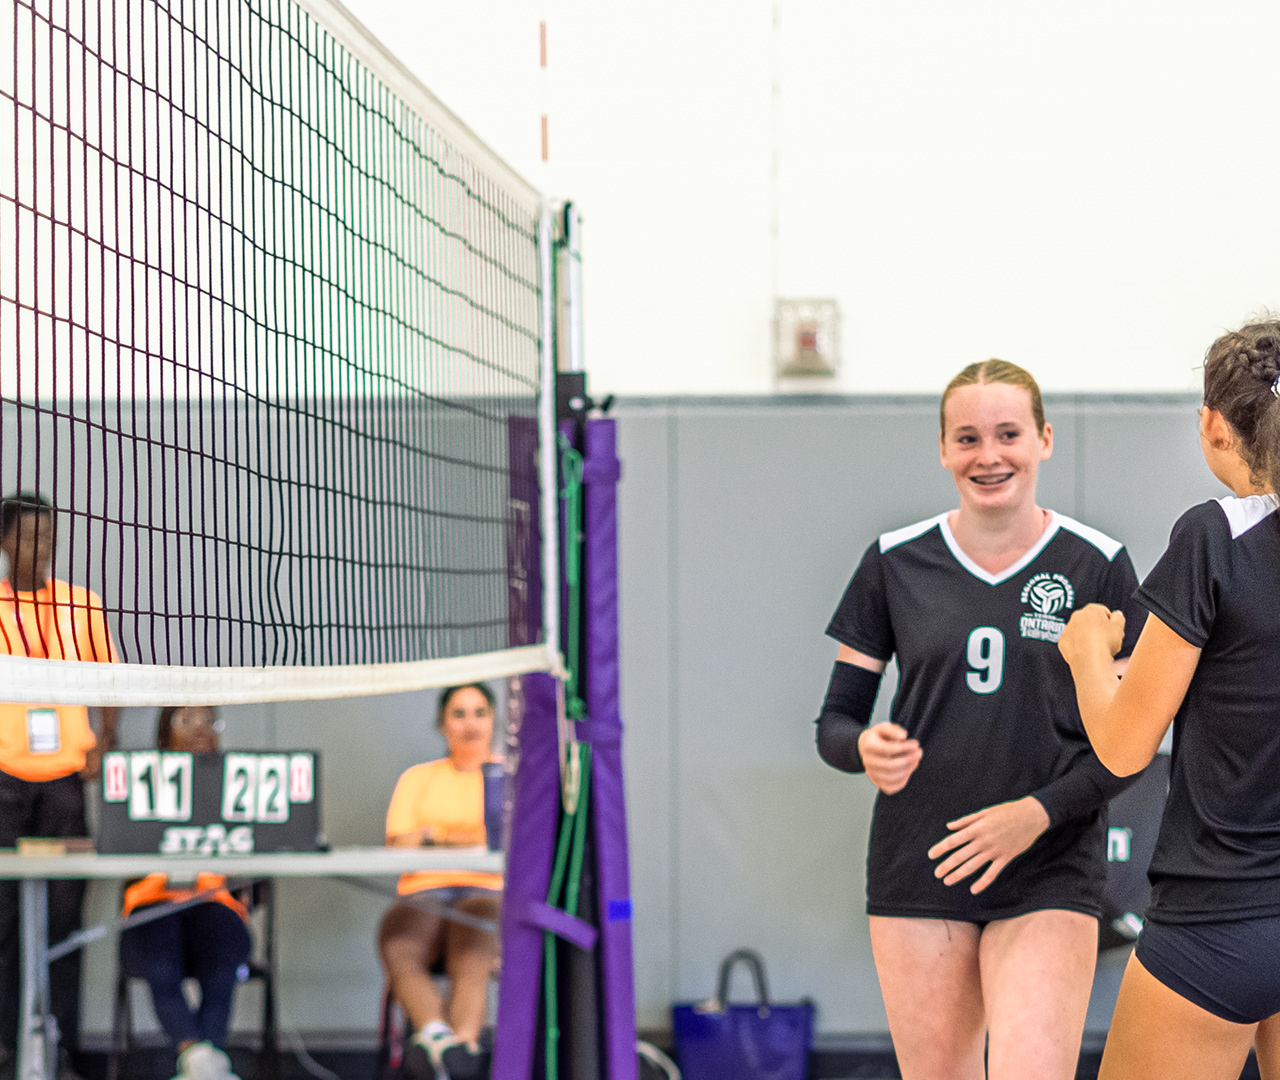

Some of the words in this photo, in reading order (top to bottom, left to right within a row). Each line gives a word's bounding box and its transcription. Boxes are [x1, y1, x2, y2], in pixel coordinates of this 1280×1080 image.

[1020, 572, 1052, 604] REGIONAL
[1051, 572, 1075, 609] PROGRAM
[1019, 616, 1066, 635] ONTARIO
[966, 626, 1005, 694] 9
[138, 764, 184, 812] 11
[232, 766, 280, 814] 22
